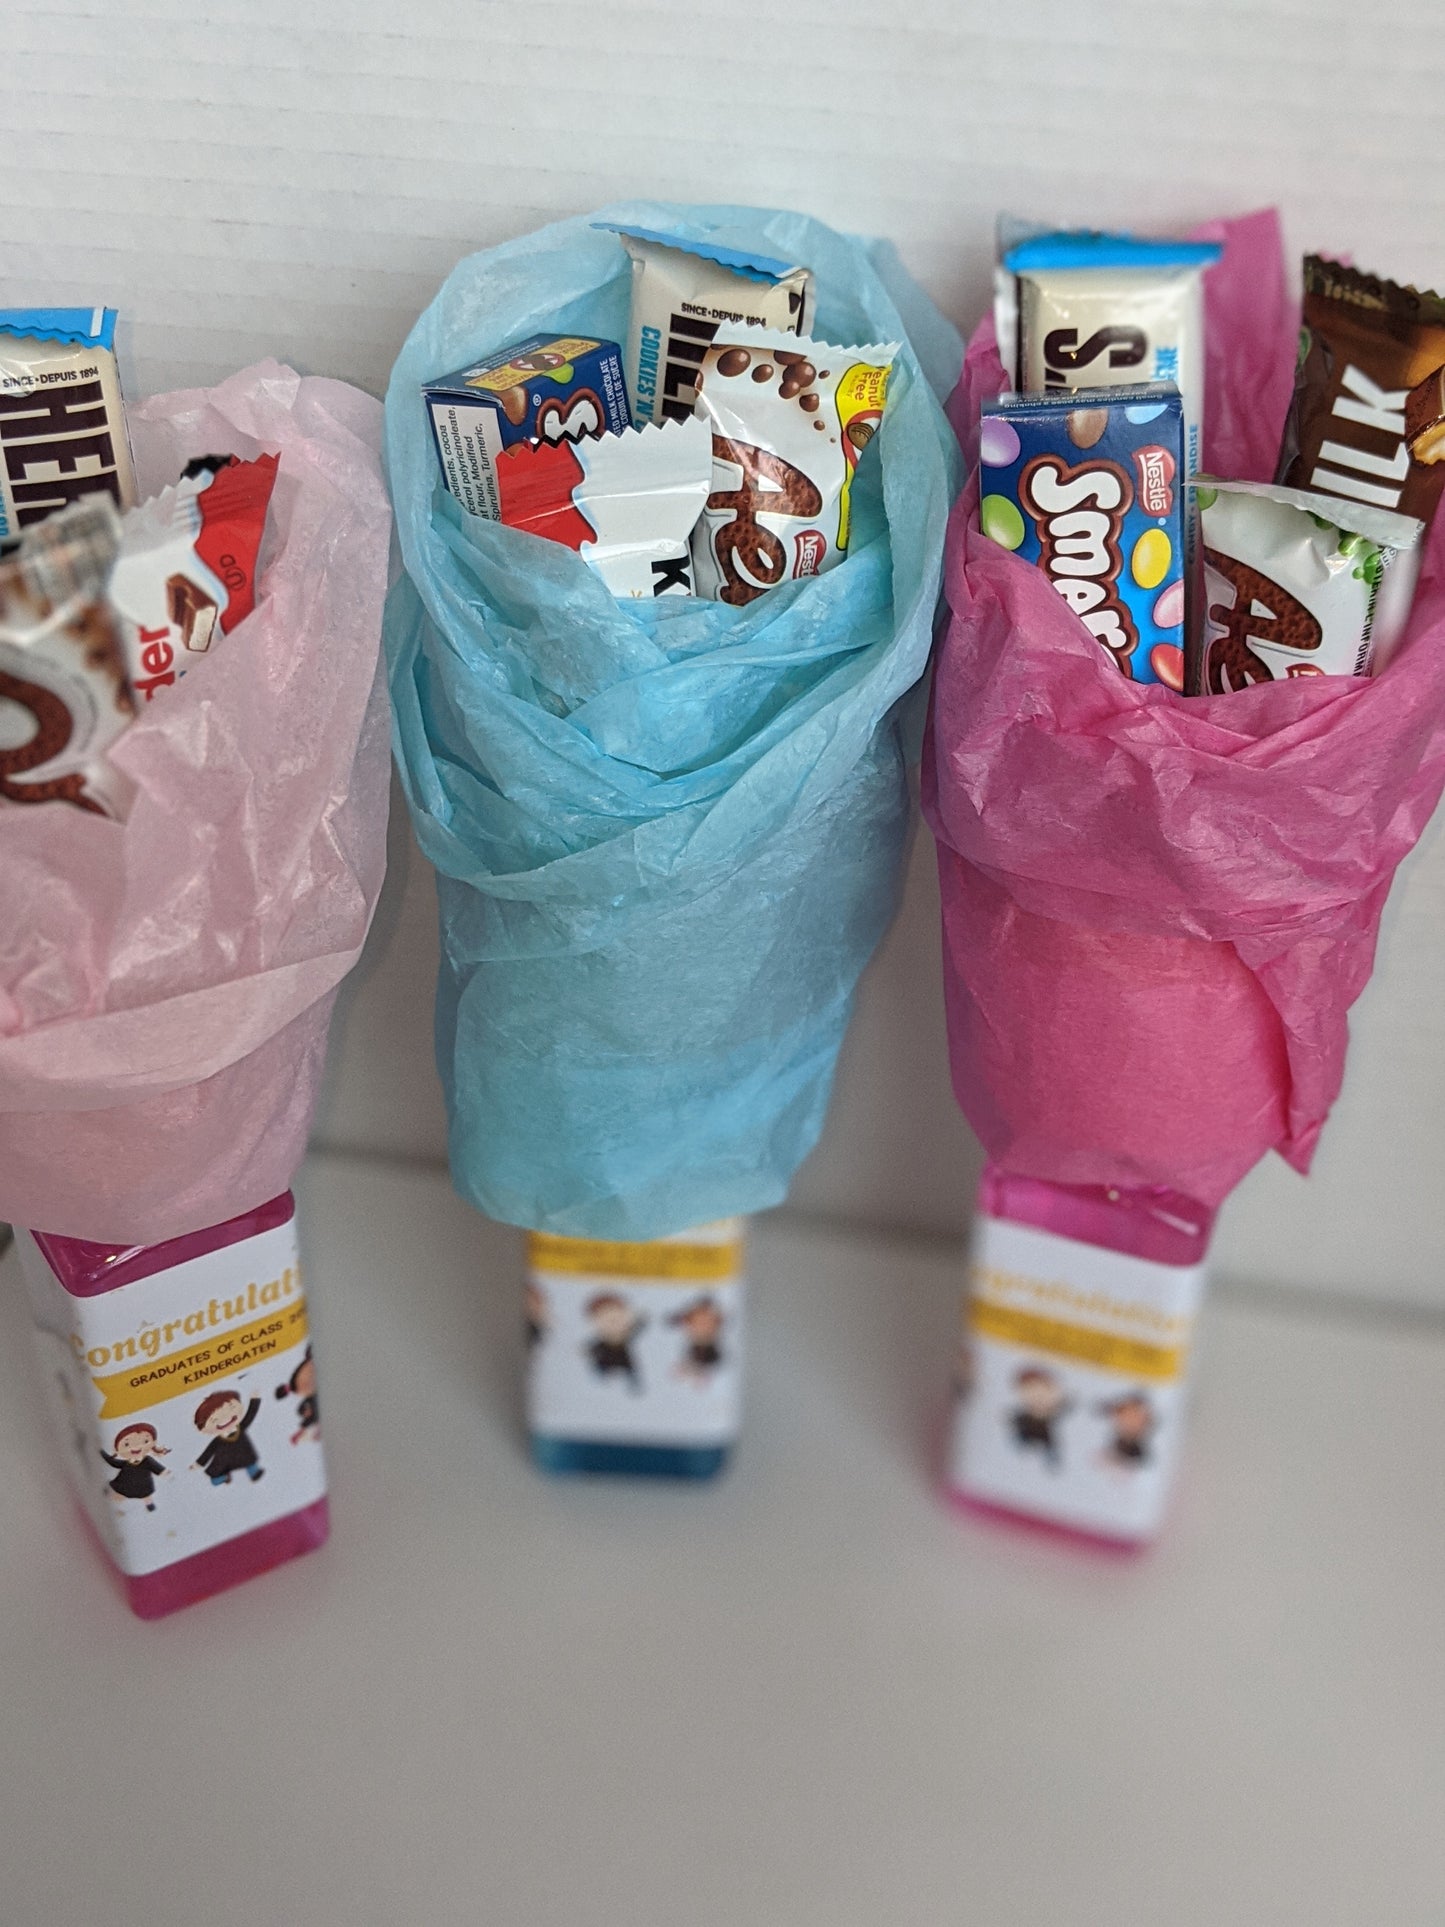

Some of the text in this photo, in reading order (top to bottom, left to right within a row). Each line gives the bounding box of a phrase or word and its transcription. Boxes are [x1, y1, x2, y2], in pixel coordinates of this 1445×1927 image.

[681, 302, 707, 317] SINCE
[609, 354, 621, 381] SUCRE
[636, 325, 661, 397] COOKIES
[3, 366, 99, 388] SINCE DEPUIS 1894
[600, 358, 616, 402] CHOCOLATE
[613, 379, 622, 391] DE
[855, 371, 871, 401] Free
[609, 400, 619, 420] MILK
[440, 425, 452, 456] cocoa
[464, 435, 480, 481] Modified
[130, 1350, 211, 1388] GRADUATES
[217, 1340, 235, 1354] OF
[240, 1320, 284, 1344] CLASS
[183, 1339, 277, 1385] KINDERGATEN
